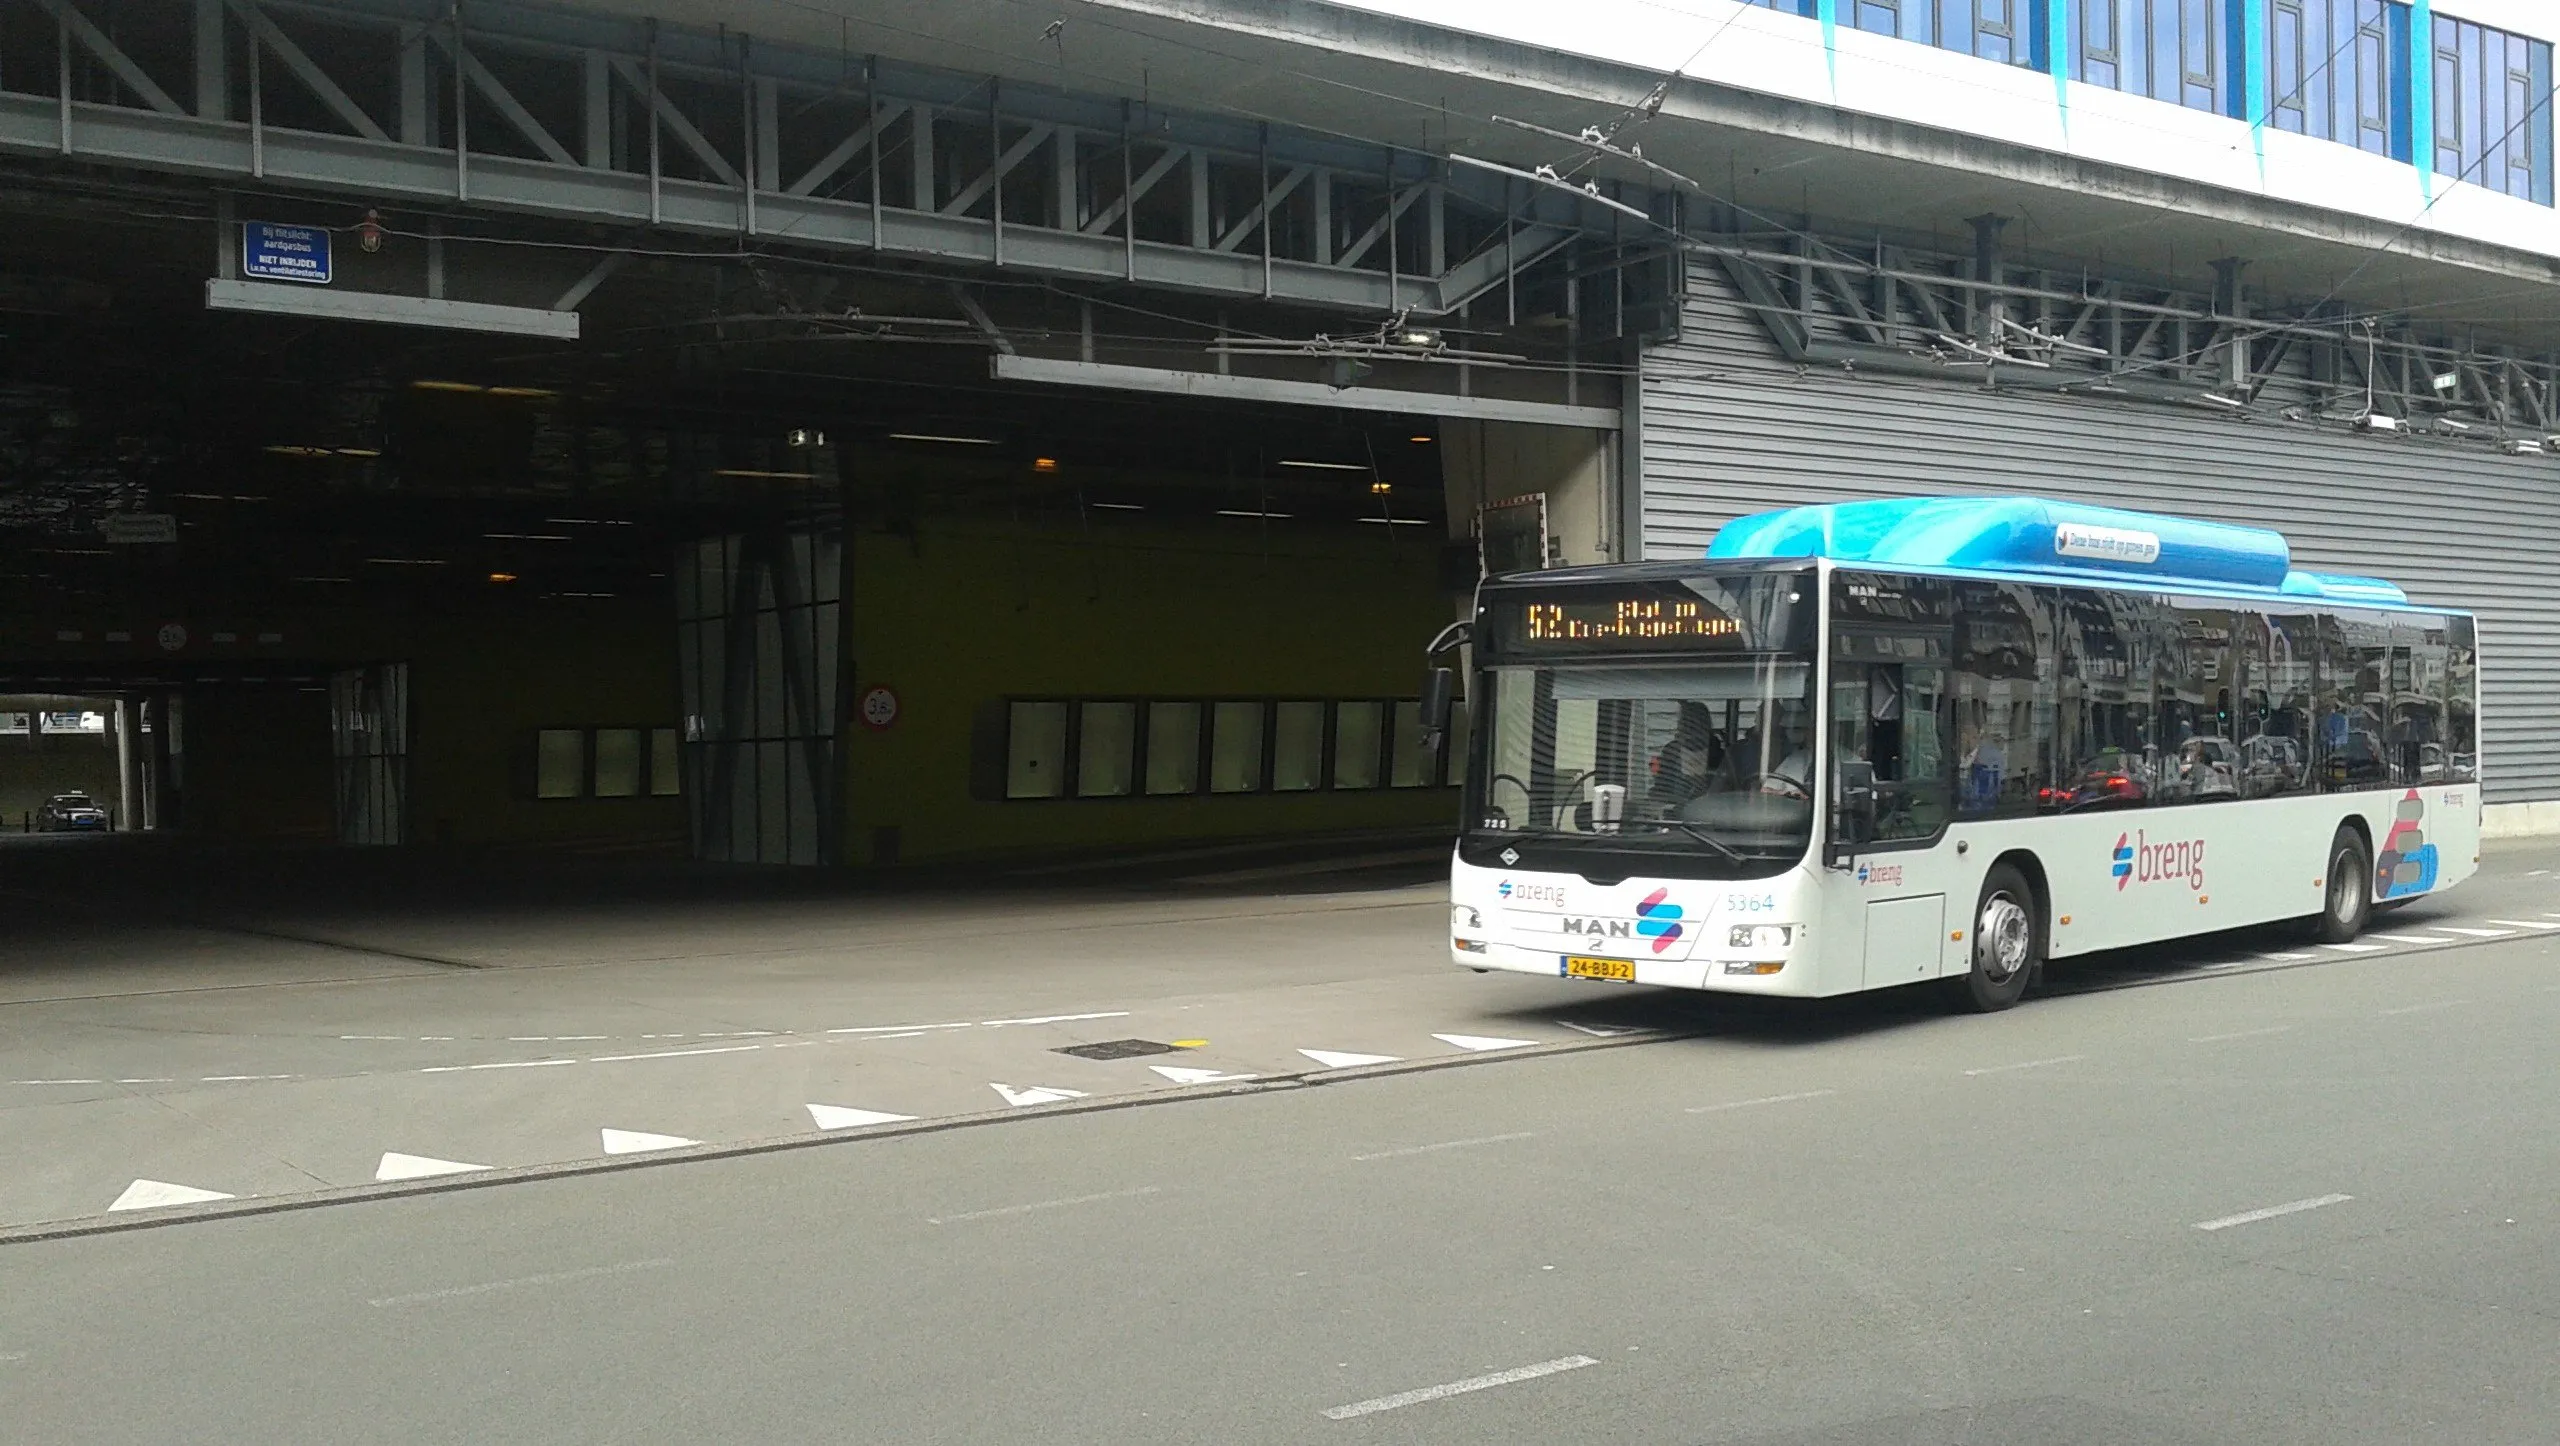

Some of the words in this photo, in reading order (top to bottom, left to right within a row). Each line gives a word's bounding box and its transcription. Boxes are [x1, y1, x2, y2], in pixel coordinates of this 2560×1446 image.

[262, 226, 274, 239] Bij
[263, 240, 312, 253] aardgasbus
[259, 254, 277, 265] NIET
[279, 256, 317, 269] INRIJDEN
[1848, 585, 1877, 597] MAN
[1529, 604, 1563, 639] 52
[2138, 828, 2205, 890] breng
[1870, 861, 1902, 887] breng
[1727, 894, 1774, 912] 5364
[1563, 917, 1630, 937] MAN
[1571, 960, 1630, 978] 24-BBJ-2
